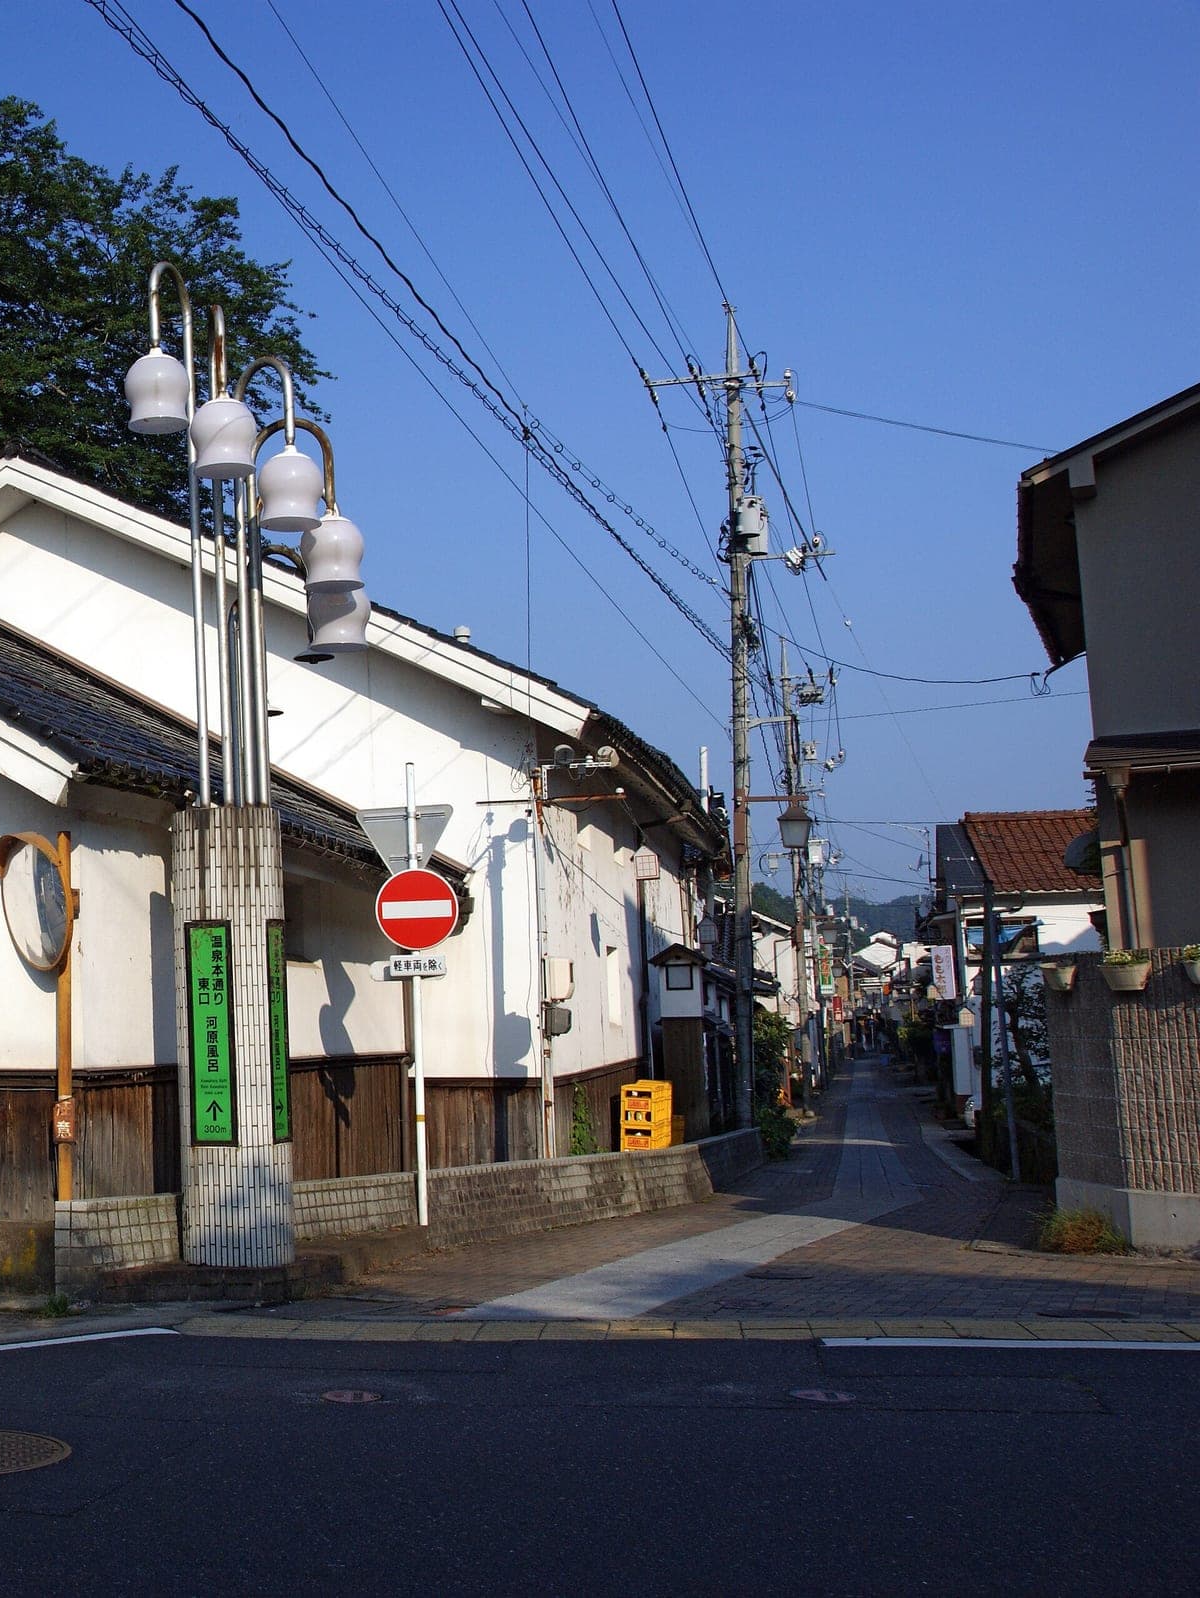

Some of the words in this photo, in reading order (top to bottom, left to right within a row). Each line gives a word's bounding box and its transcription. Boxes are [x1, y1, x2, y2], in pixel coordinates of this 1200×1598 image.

[211, 935, 224, 1006] 温泉本通り
[393, 959, 441, 971] 軽車両を除く
[198, 978, 210, 1006] 東口
[206, 1016, 219, 1073] 河原風呂
[204, 1125, 227, 1134] 300m
